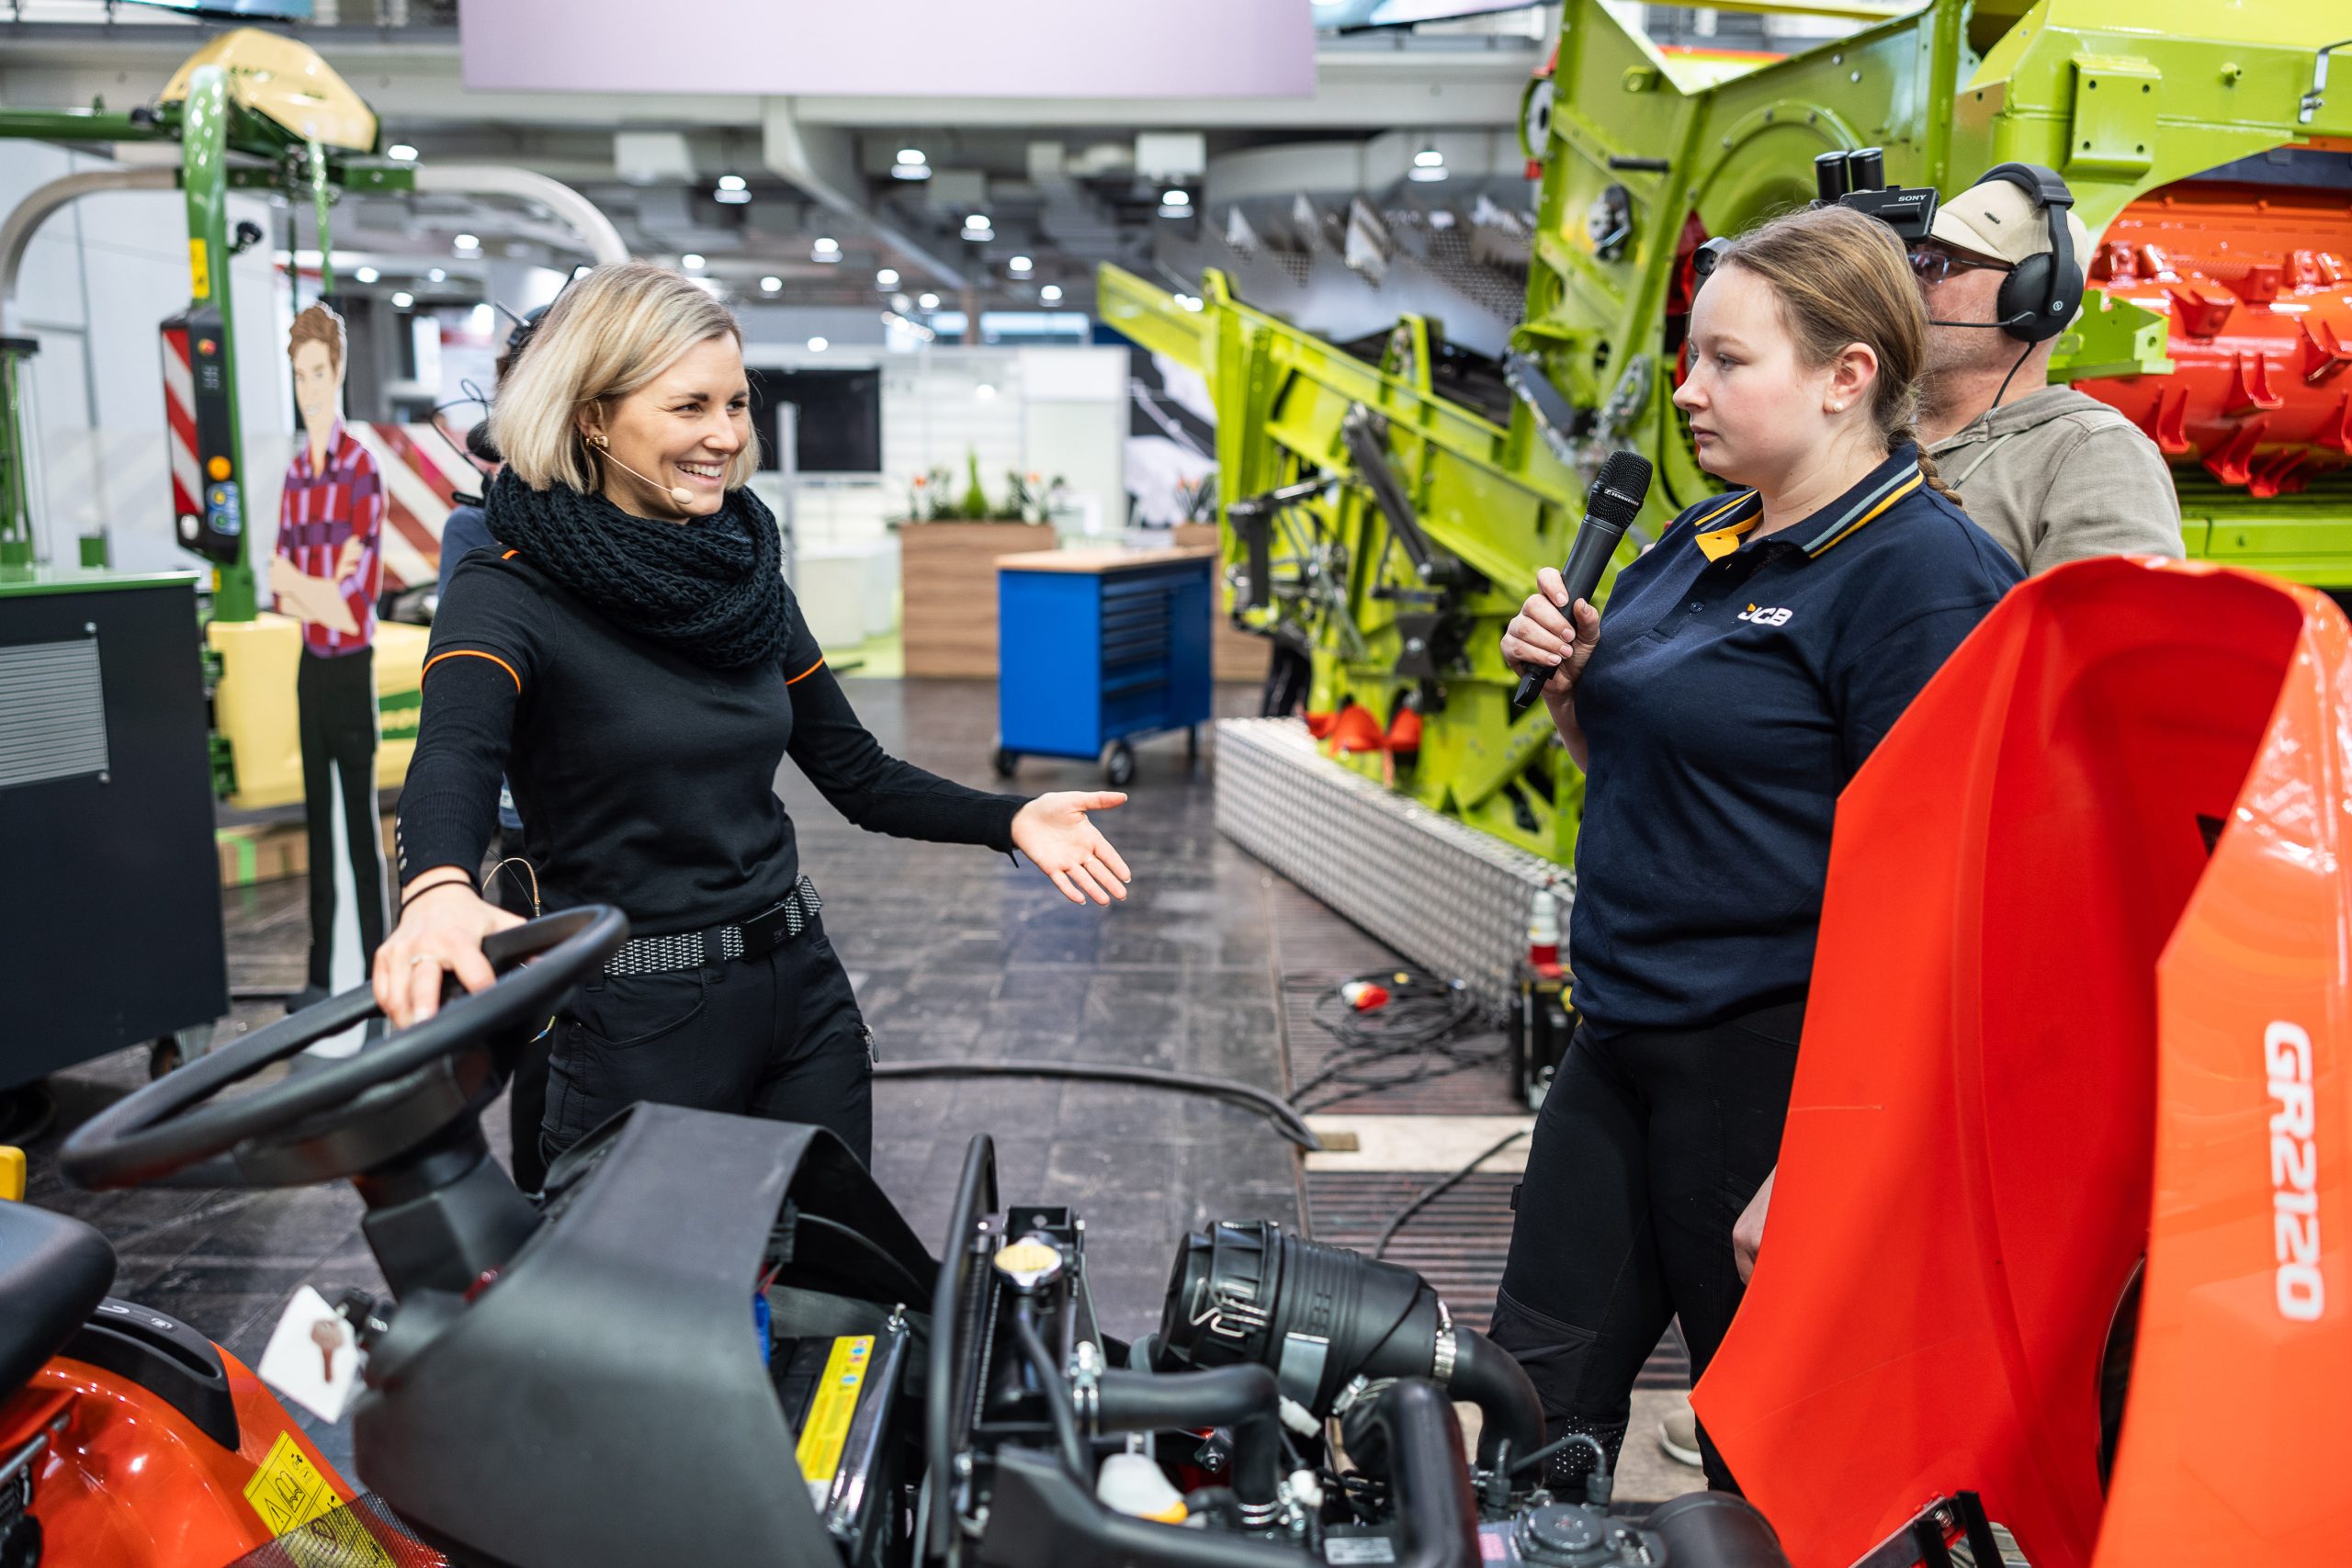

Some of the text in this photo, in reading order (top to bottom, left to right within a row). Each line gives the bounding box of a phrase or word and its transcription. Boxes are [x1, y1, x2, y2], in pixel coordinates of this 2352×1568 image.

[1611, 491, 1639, 506] SENNHEISER
[1737, 603, 1792, 626] JCB
[2264, 1021, 2324, 1321] GR2120
